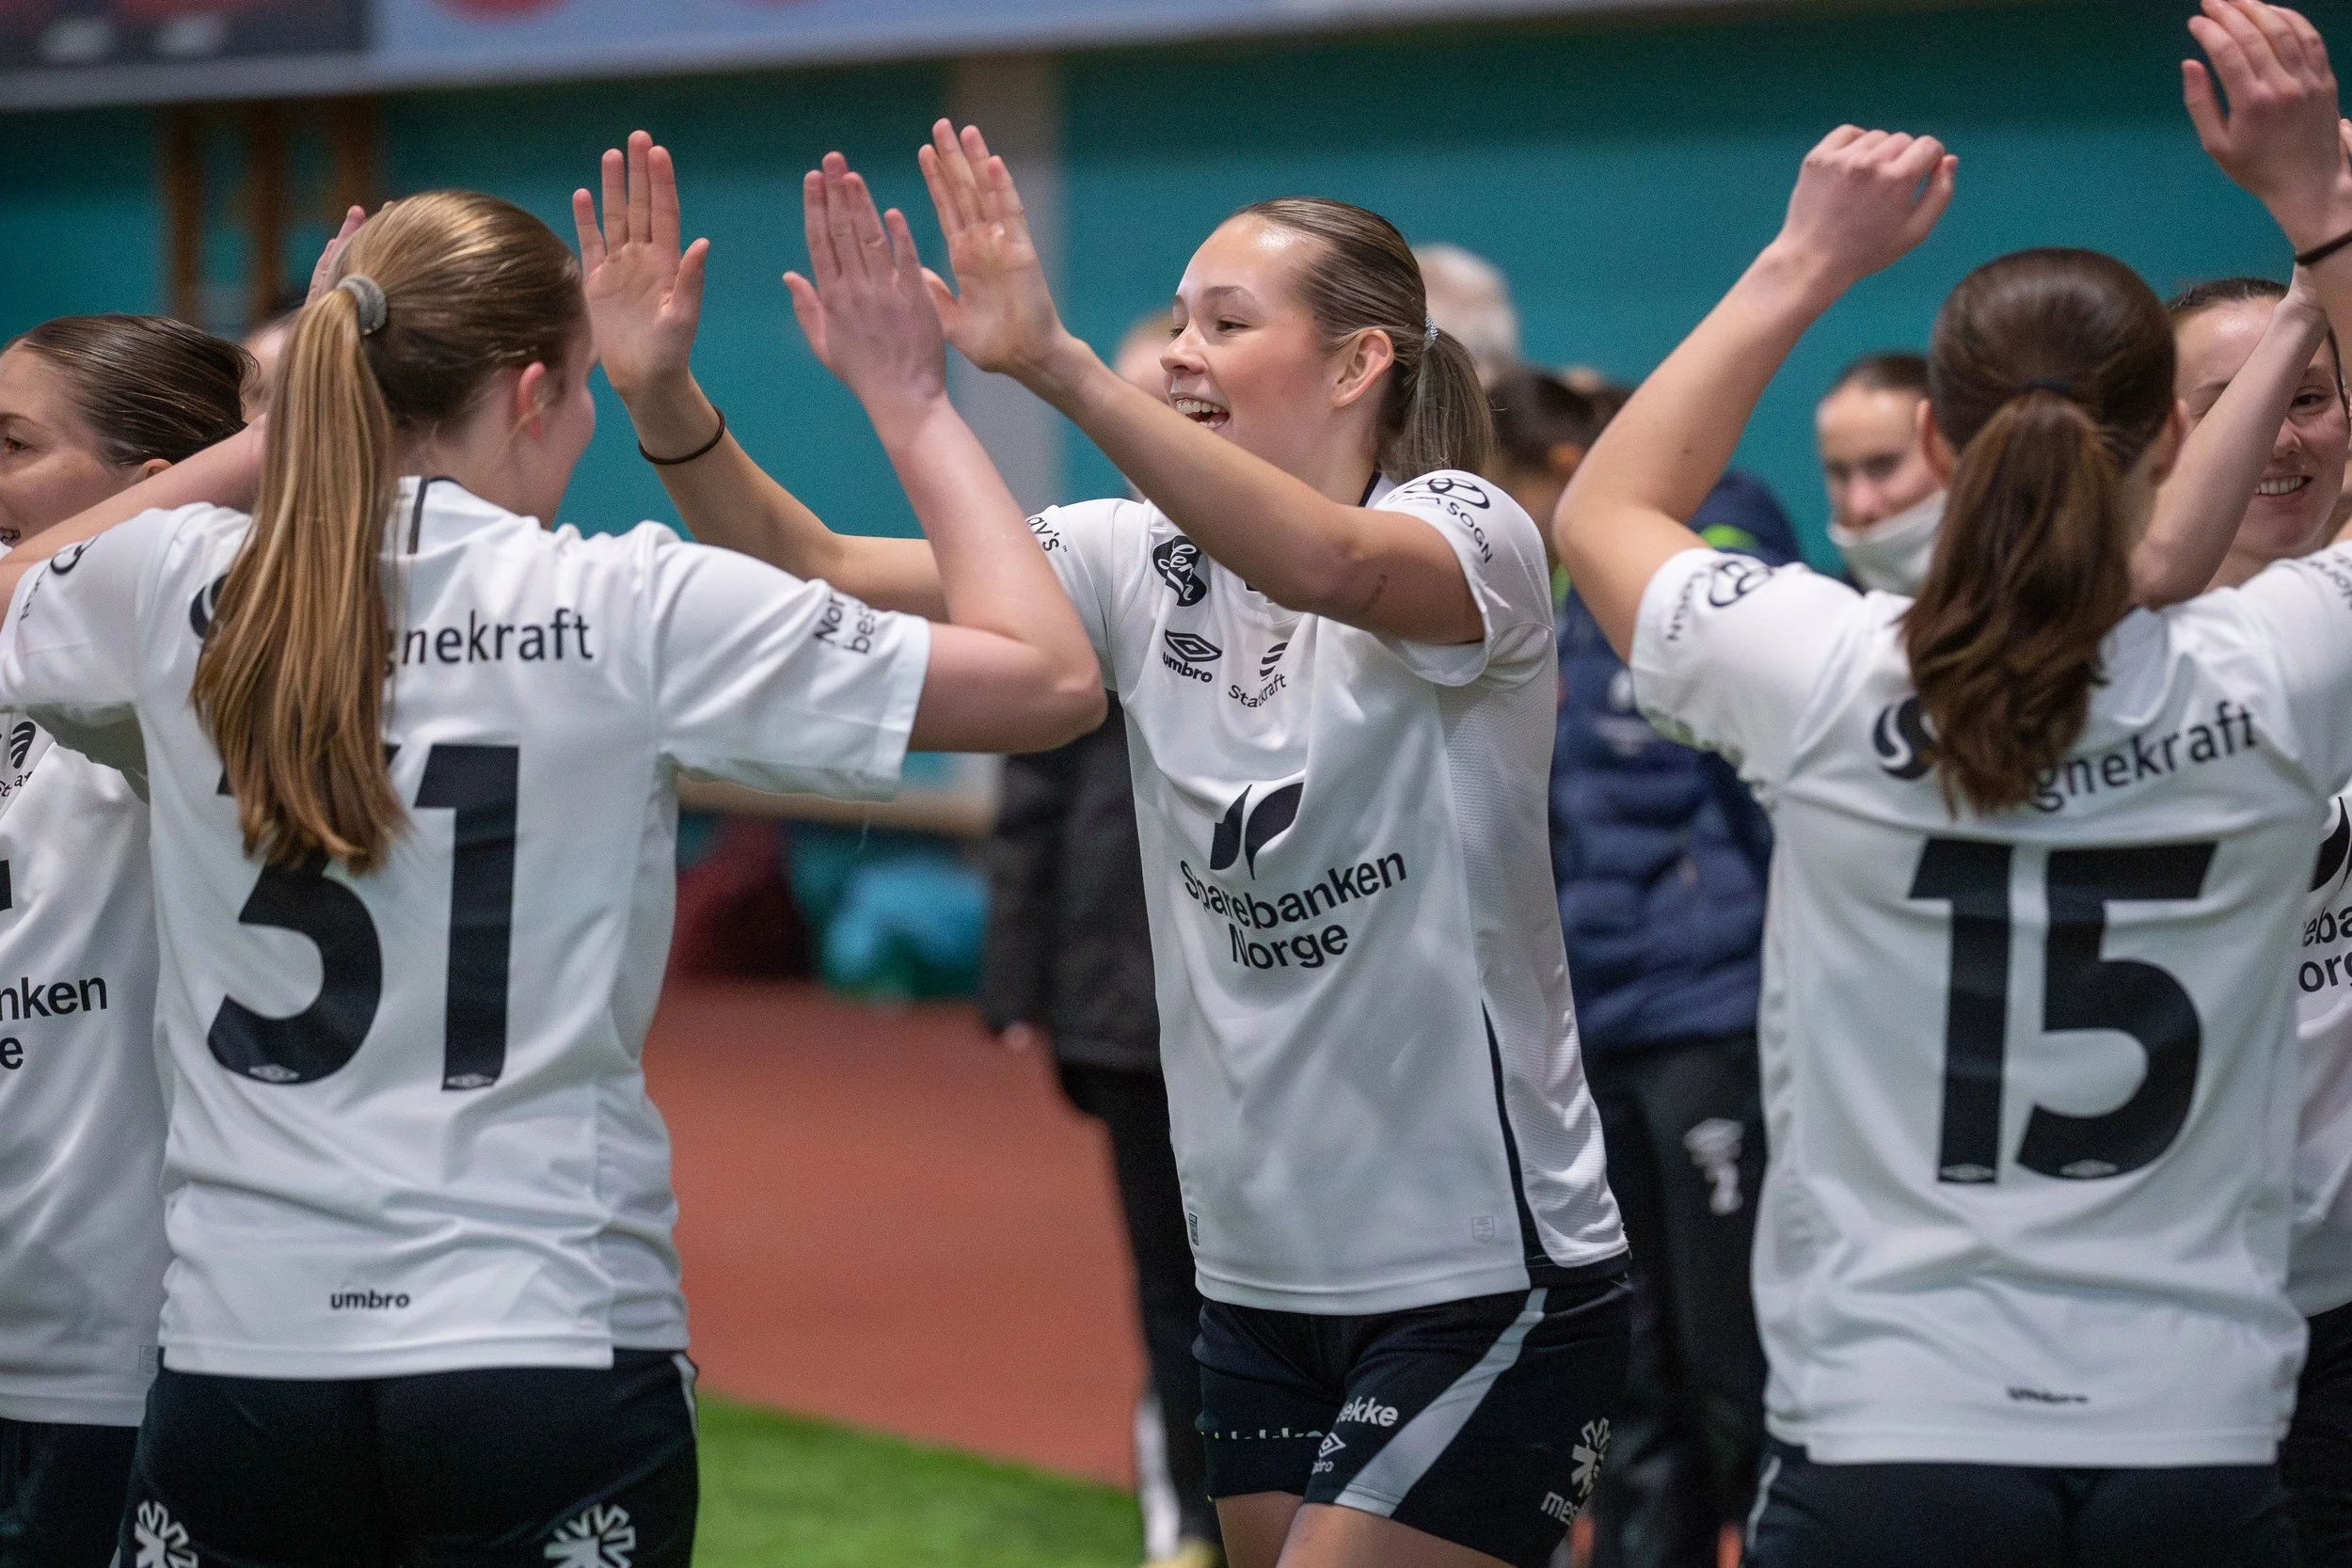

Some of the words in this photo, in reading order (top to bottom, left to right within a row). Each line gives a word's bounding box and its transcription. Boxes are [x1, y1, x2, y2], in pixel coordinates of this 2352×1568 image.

[1447, 501, 1493, 564] SOGN
[387, 607, 594, 676] nekraft
[813, 594, 845, 645] Nor
[1163, 651, 1214, 684] umbro
[1228, 673, 1287, 708] Statkraft
[2028, 700, 2258, 814] gnekraft
[1180, 851, 1408, 929] Sparebanken
[207, 742, 520, 1092] 31
[2302, 906, 2352, 947] eba
[1228, 924, 1349, 970] Norge
[0, 975, 108, 1022] nken
[1907, 835, 2220, 1185] 15
[0, 1037, 24, 1070] e
[330, 1289, 411, 1310] umbro
[1336, 1396, 1399, 1428] ekke
[1540, 1490, 1580, 1527] mes
